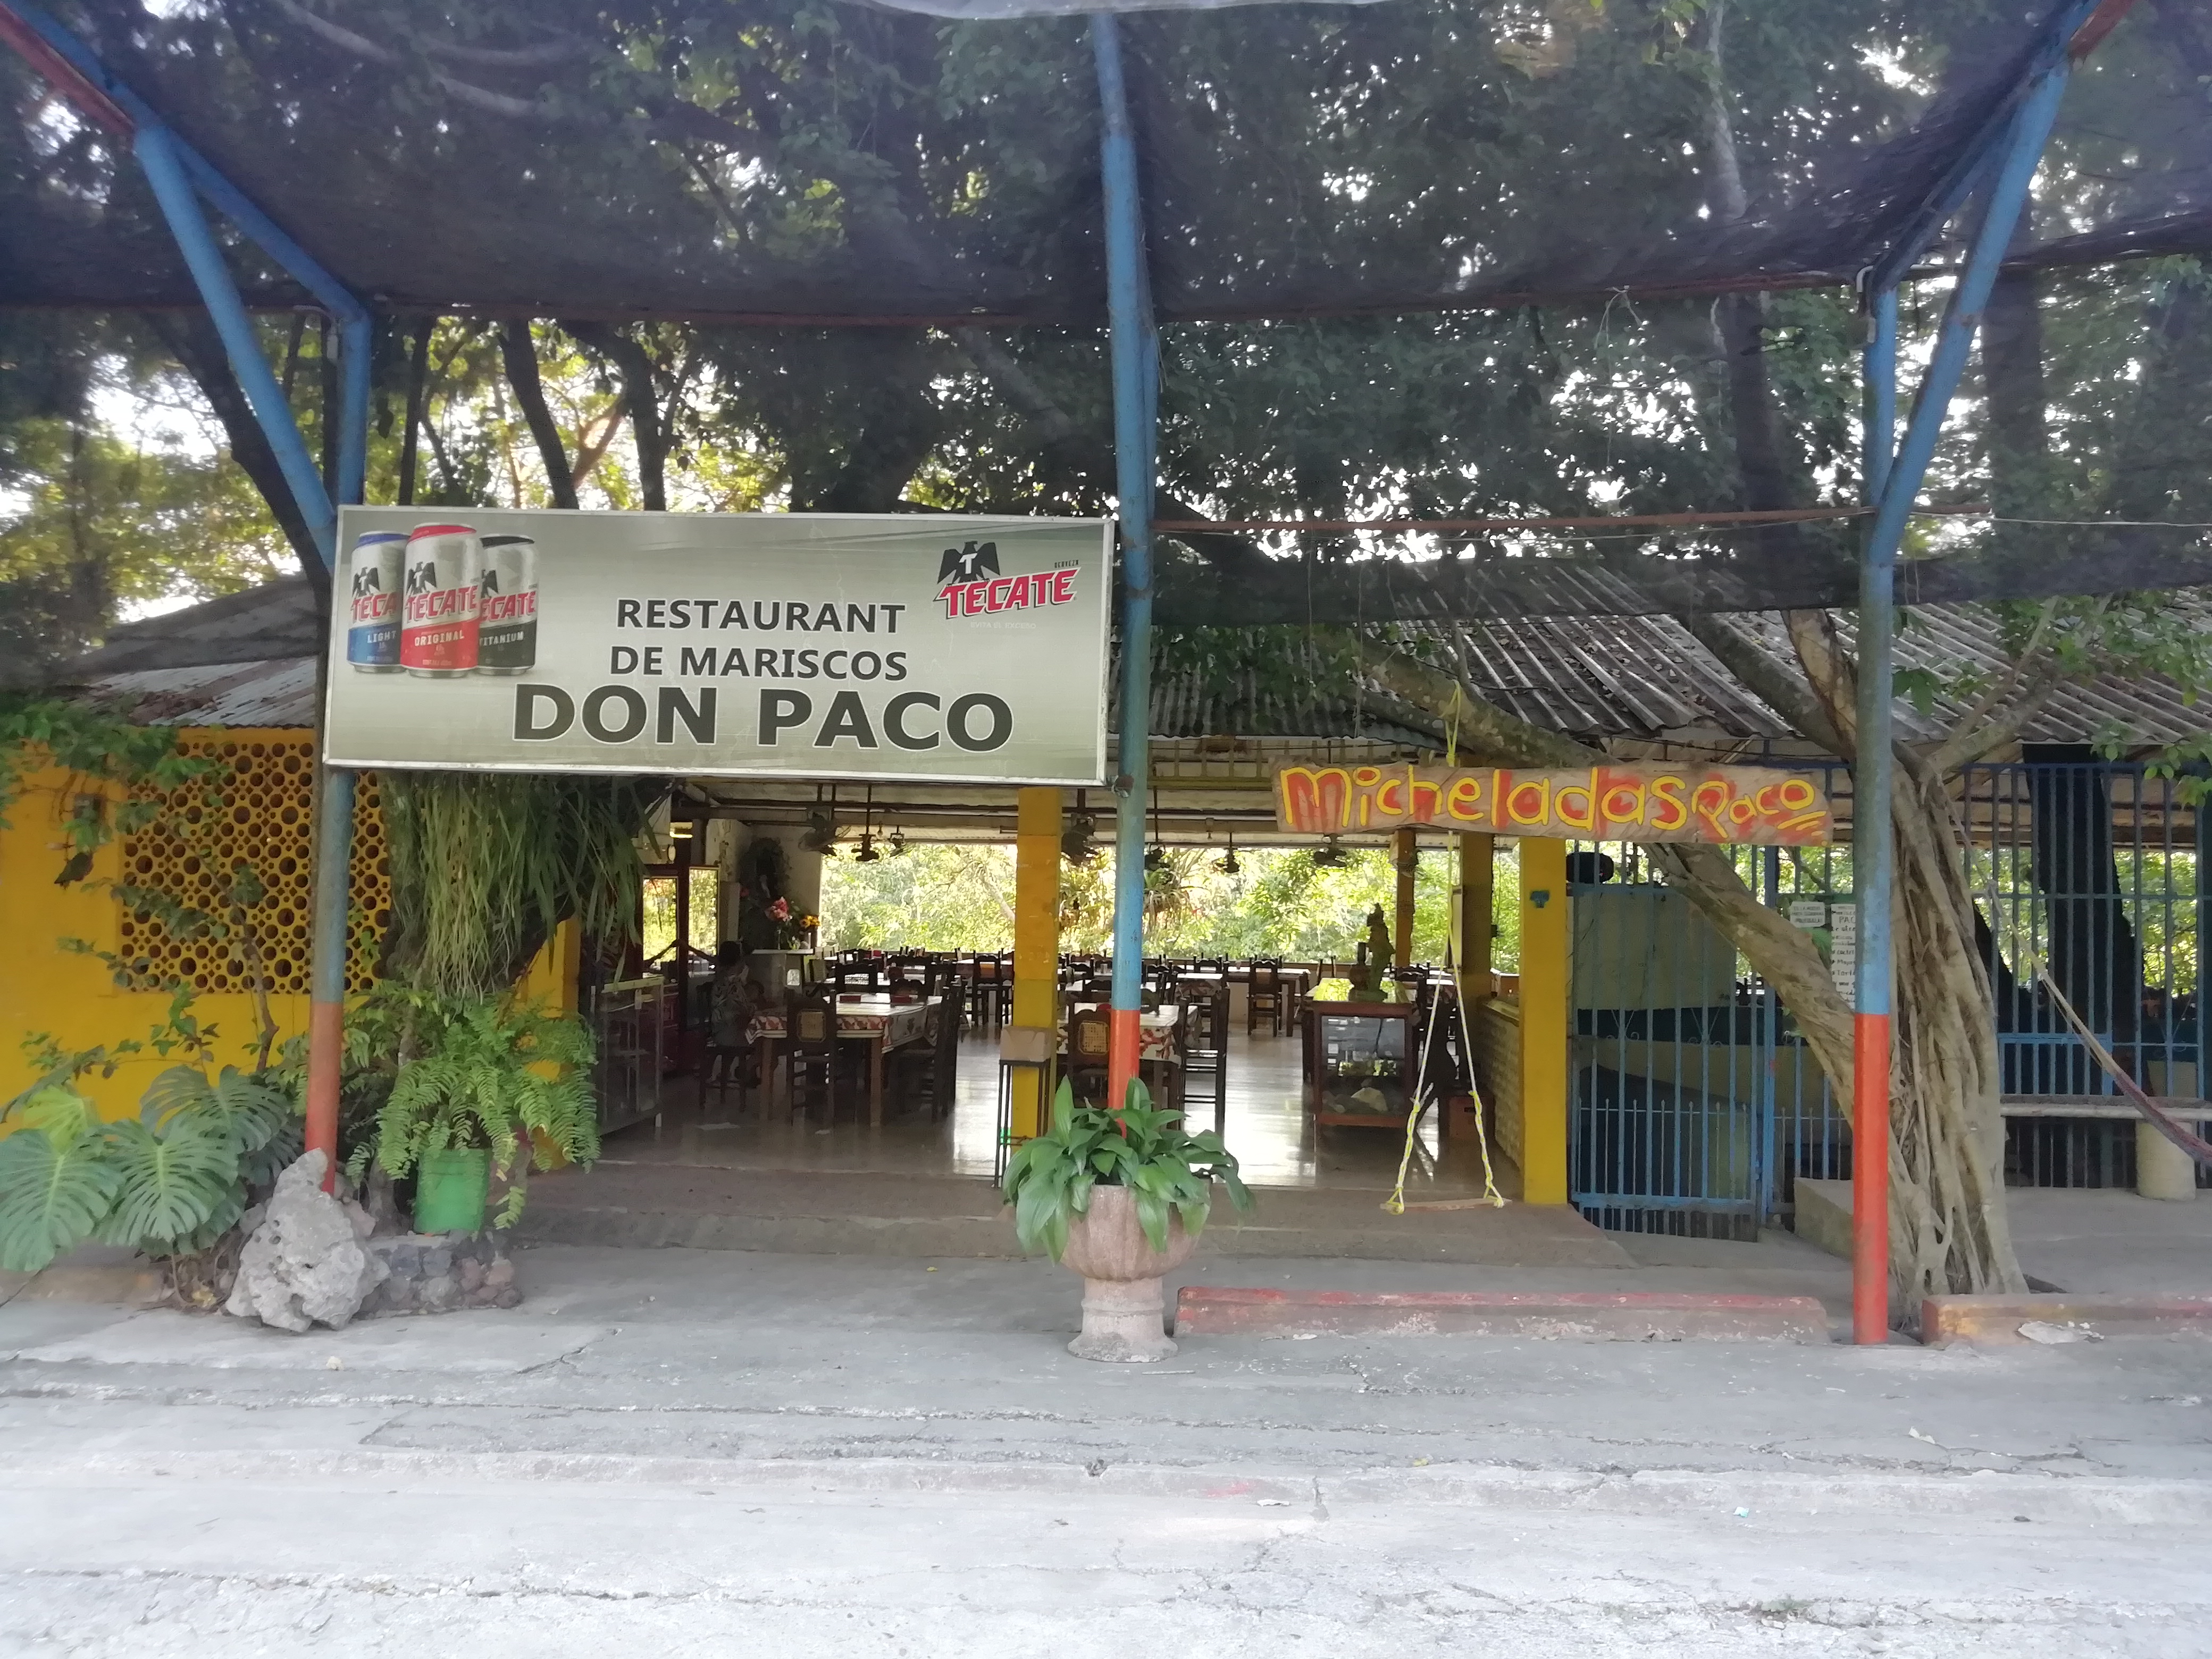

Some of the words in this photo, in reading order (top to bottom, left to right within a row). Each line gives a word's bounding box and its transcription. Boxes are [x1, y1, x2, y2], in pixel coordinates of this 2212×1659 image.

[405, 584, 479, 622] TECATE
[933, 567, 1082, 619] TECATE
[617, 599, 906, 633] RESTAURANT
[367, 630, 397, 643] LIGHT
[415, 630, 465, 647] ORIGINAL
[610, 646, 664, 675] DE
[680, 646, 908, 681] MARISCOS
[513, 682, 718, 745] DON
[756, 687, 1014, 752] PACO
[1691, 772, 1816, 839] Paco
